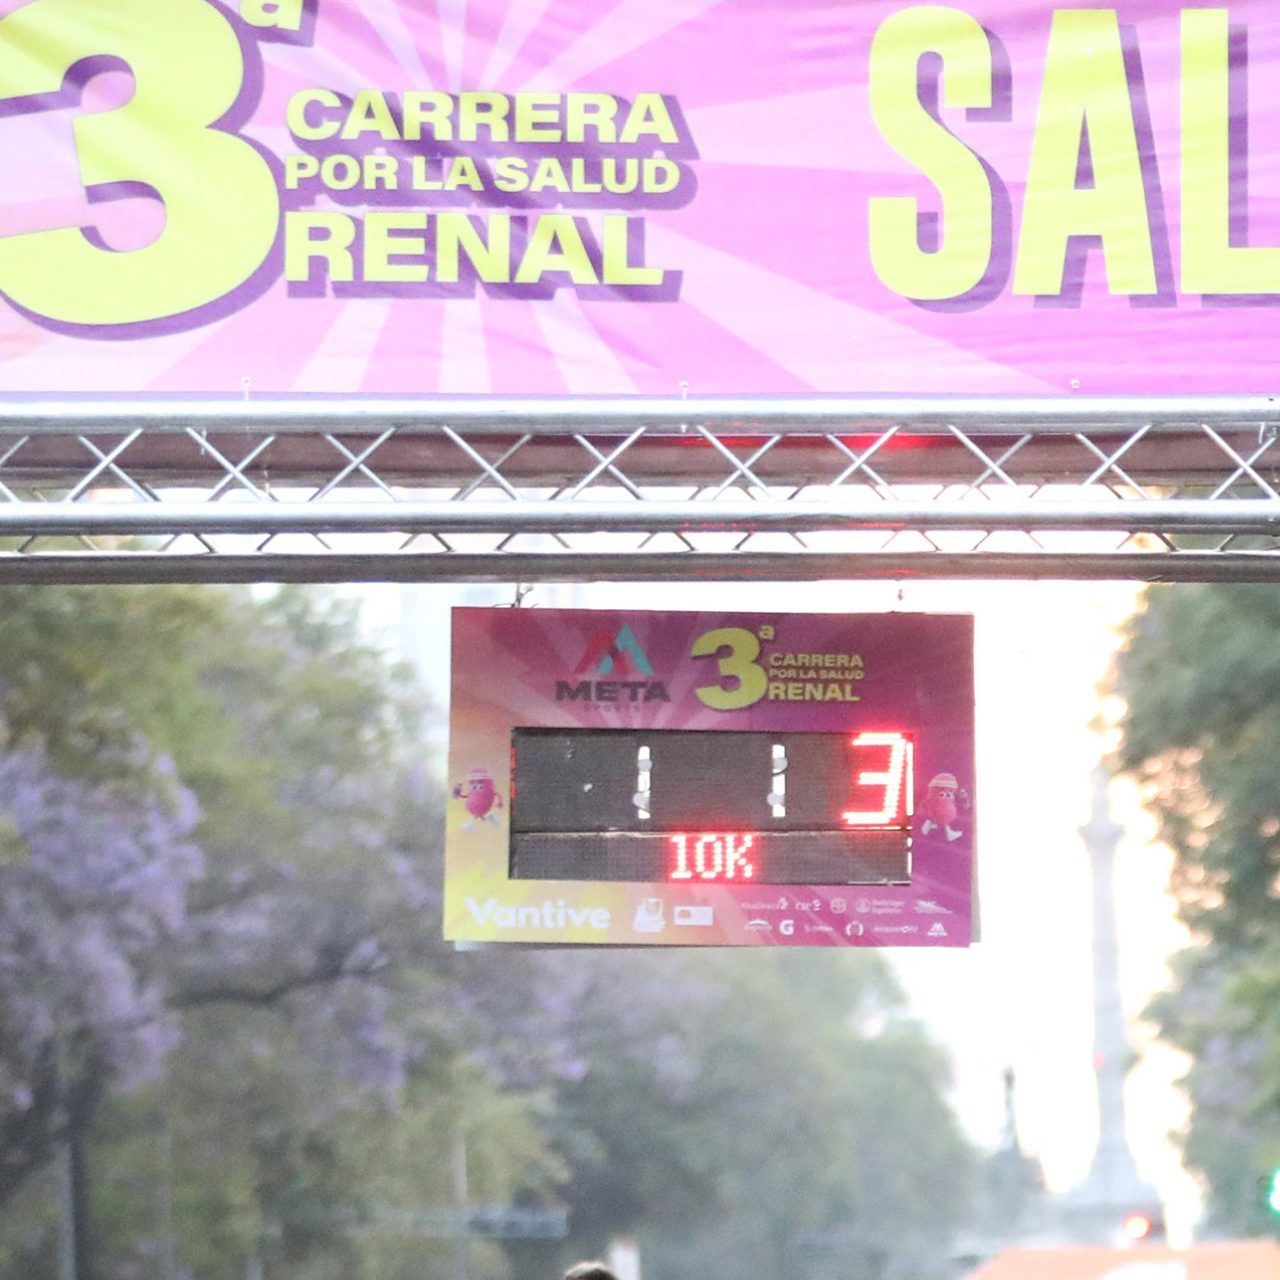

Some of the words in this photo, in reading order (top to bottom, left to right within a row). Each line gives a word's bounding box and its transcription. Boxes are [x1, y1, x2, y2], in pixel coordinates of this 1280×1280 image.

[284, 87, 680, 144] CARRERA
[285, 154, 398, 191] POR
[411, 156, 484, 192] LA
[496, 156, 681, 194] SALUD
[284, 210, 664, 287] RENAL
[769, 653, 864, 668] CARRERA
[769, 668, 797, 679] POR
[800, 669, 818, 680] LA
[820, 669, 865, 681] SALUD
[556, 680, 672, 703] META
[768, 682, 861, 702] RENAL
[669, 833, 755, 880] 10K
[464, 898, 611, 932] Vantive
